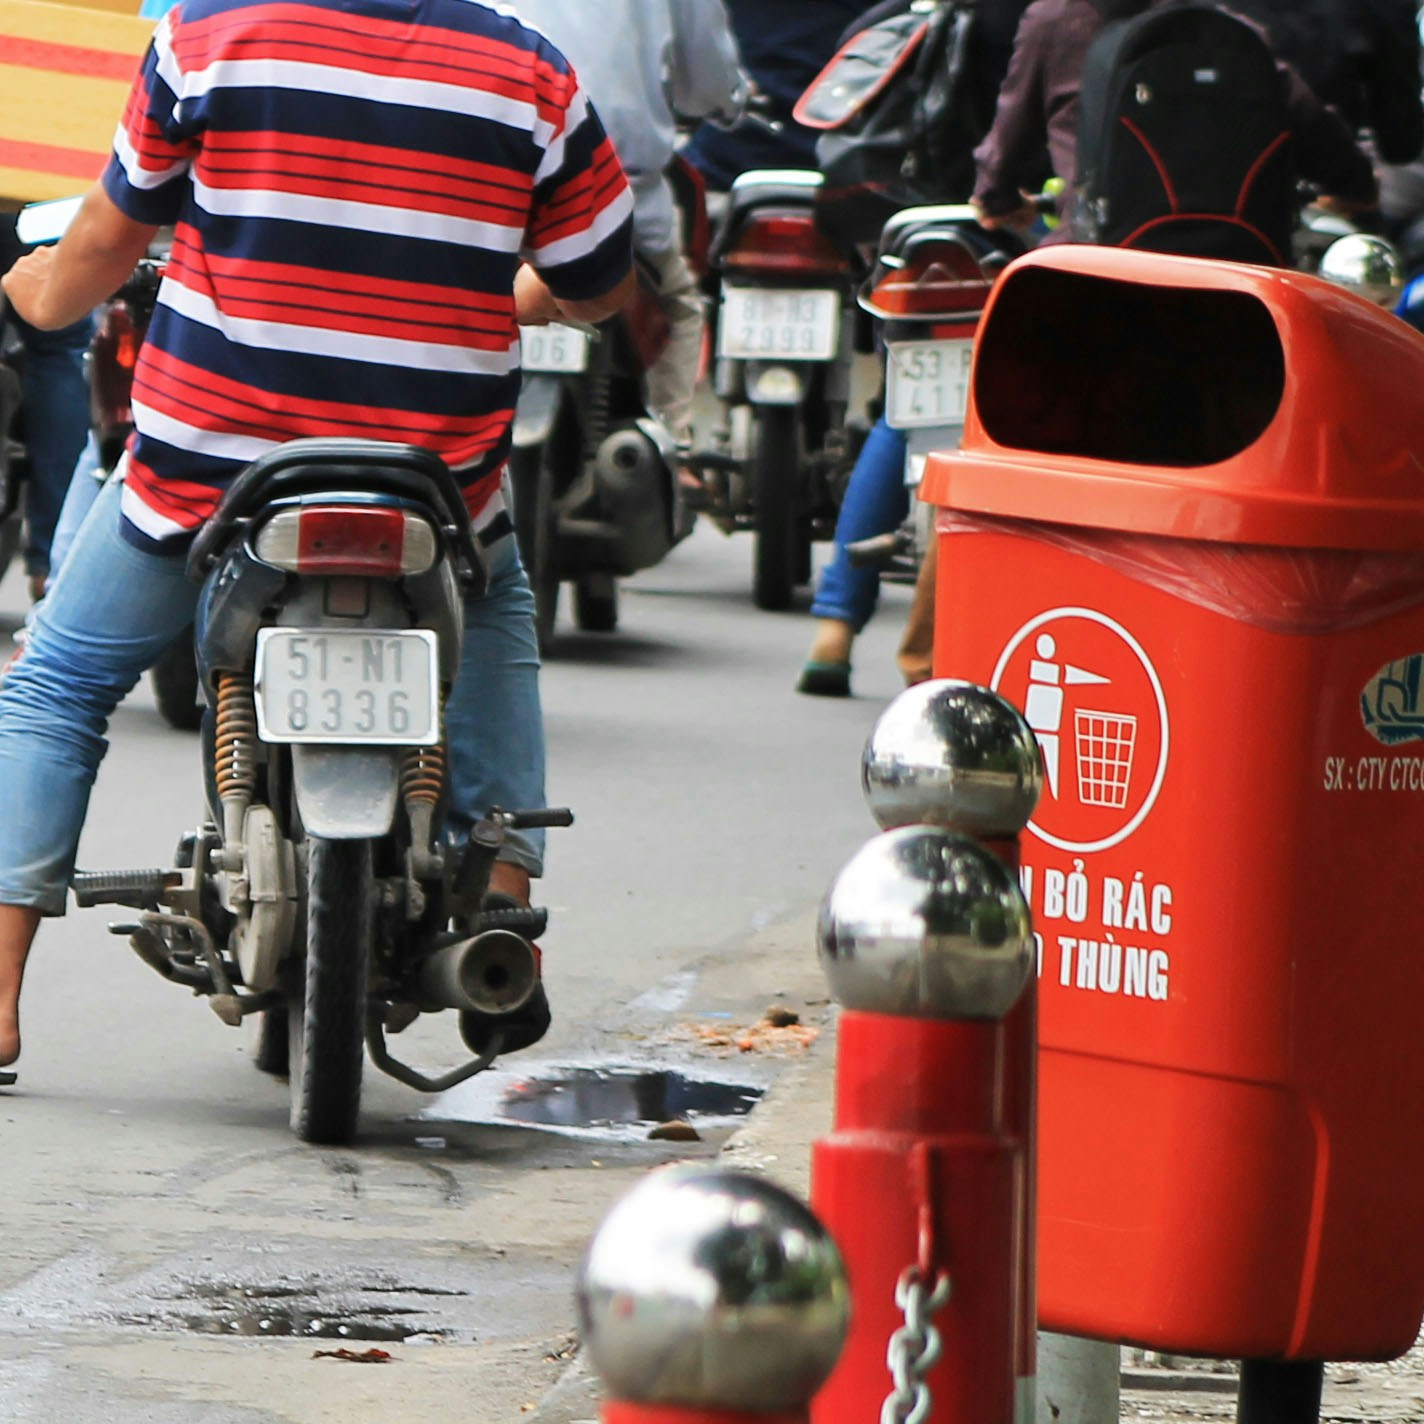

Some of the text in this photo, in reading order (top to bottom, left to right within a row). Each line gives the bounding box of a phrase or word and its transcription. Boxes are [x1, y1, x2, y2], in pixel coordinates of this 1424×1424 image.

[287, 636, 404, 683] 51-N1
[287, 689, 409, 734] 8336
[1323, 756, 1346, 792] SX
[1356, 756, 1388, 792] CTY
[1043, 858, 1089, 923] BỎ
[1102, 870, 1173, 936] RÁC
[1057, 931, 1170, 1001] THÙNG
